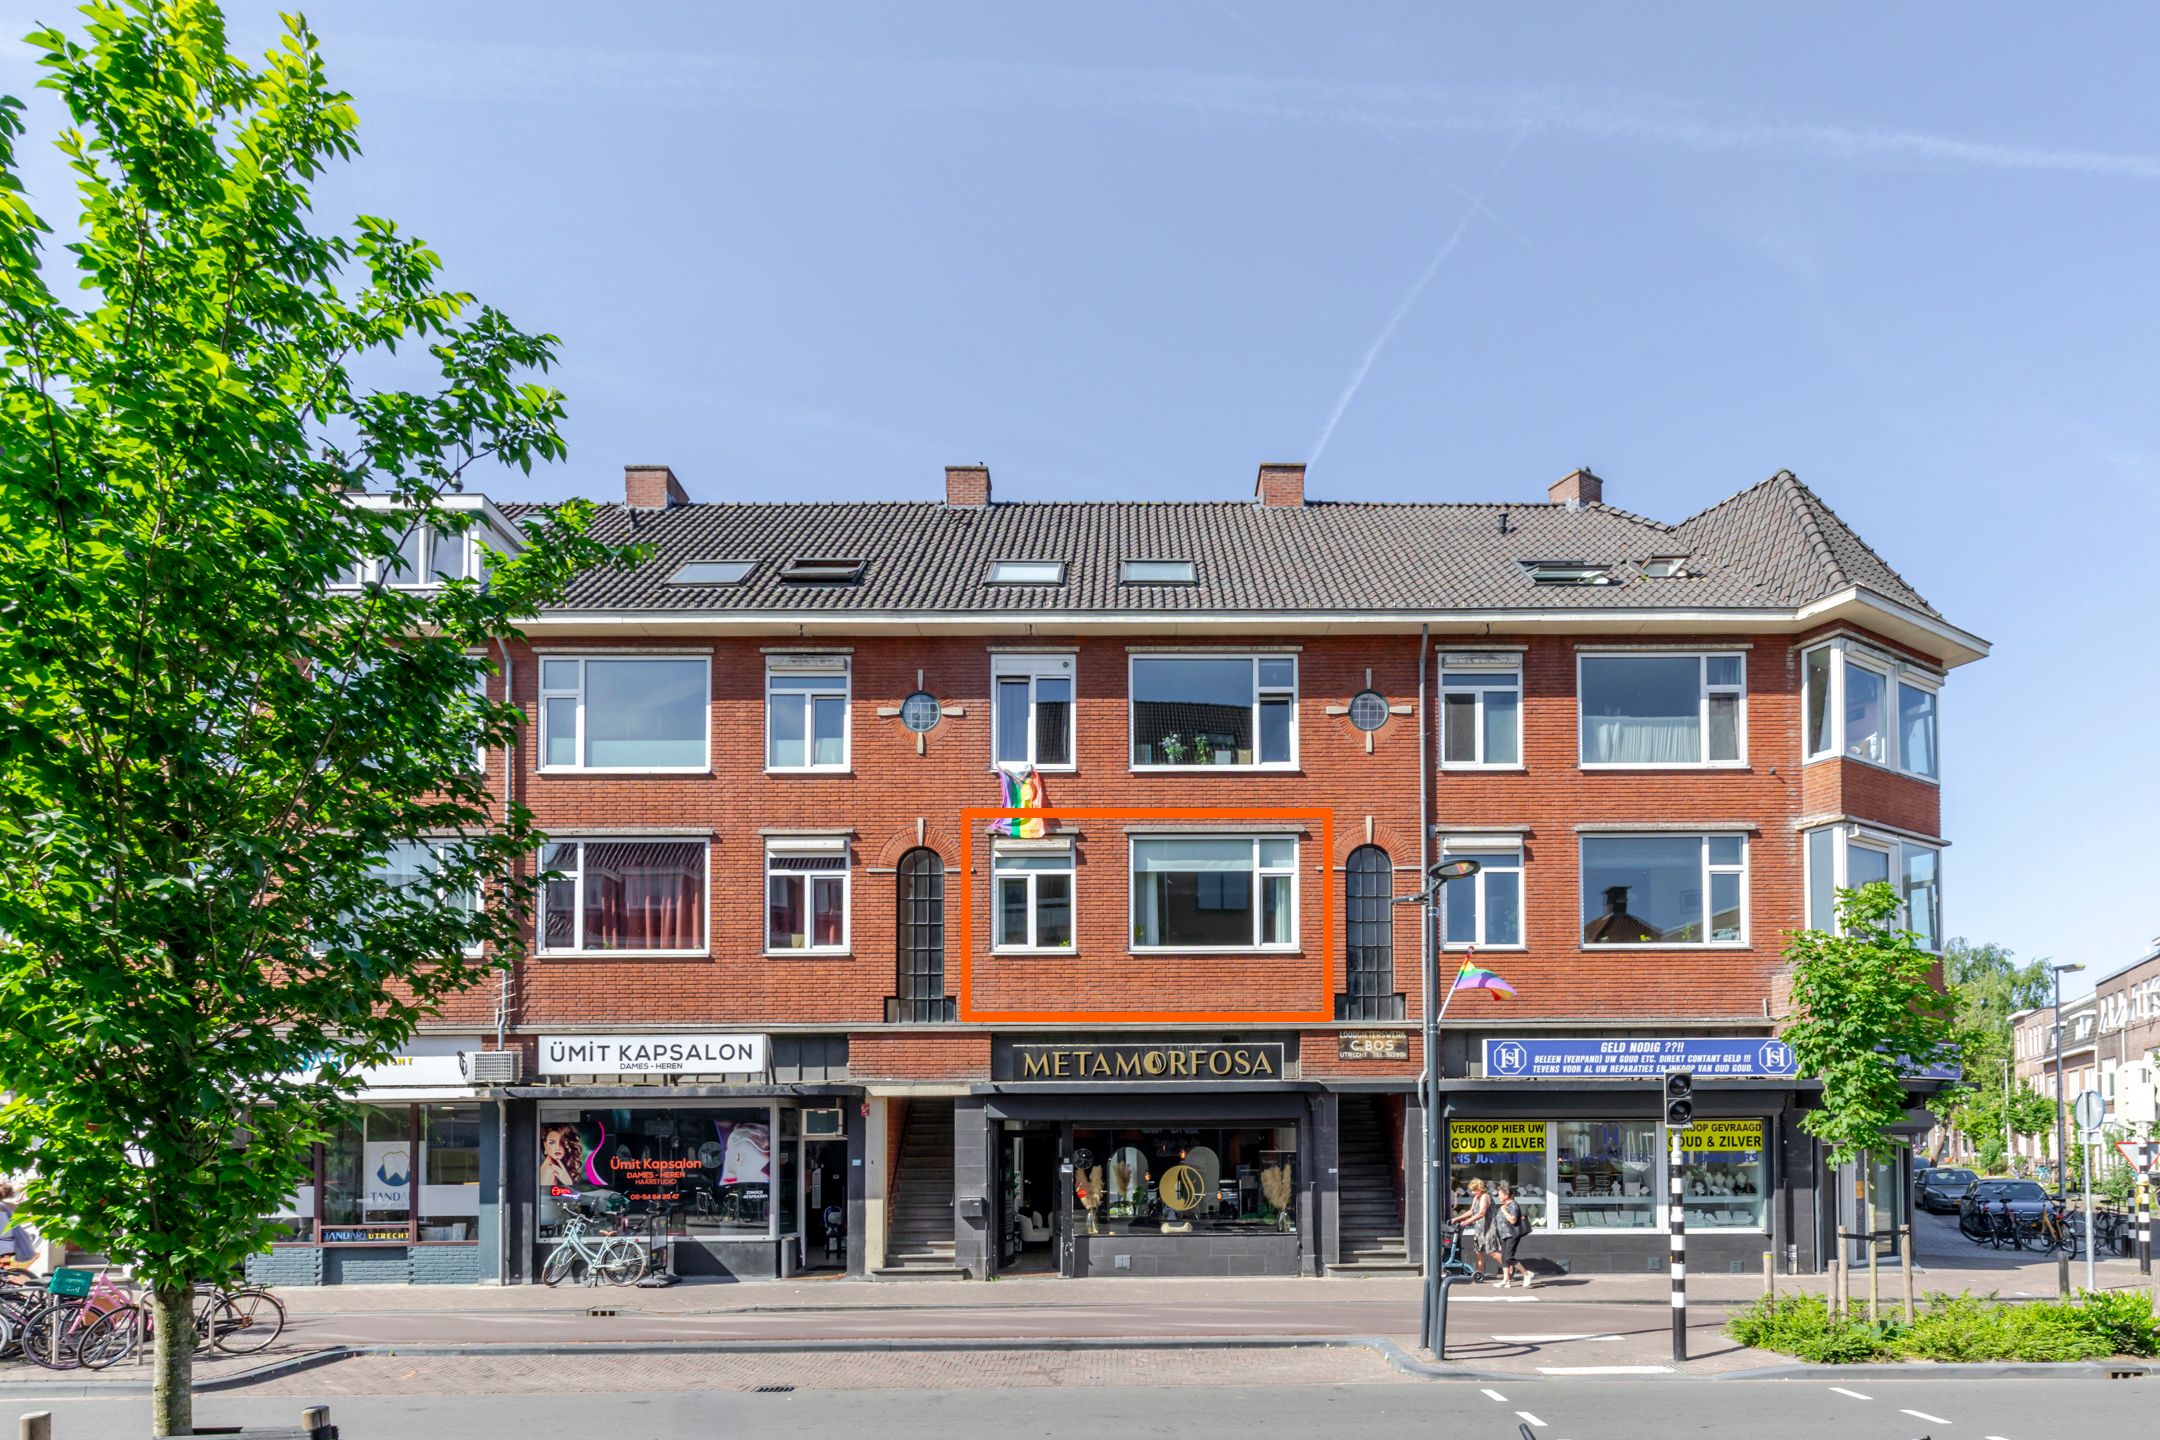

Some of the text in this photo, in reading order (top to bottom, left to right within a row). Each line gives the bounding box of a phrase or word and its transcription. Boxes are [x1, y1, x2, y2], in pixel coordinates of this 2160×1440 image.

[1365, 1040, 1394, 1051] BOS
[1600, 1041, 1685, 1053] GELD NODIG ??!!
[619, 1043, 753, 1061] KAPSALON
[1023, 1050, 1274, 1077] METAMORFOSA
[1534, 1055, 1562, 1064] BELEEN
[1563, 1054, 1603, 1064] (VERPAND)
[1604, 1055, 1618, 1063] UW
[1619, 1055, 1639, 1063] GOUD
[1641, 1054, 1657, 1063] ETC.
[1659, 1054, 1686, 1063] DIREKT
[1687, 1054, 1721, 1063] CONTANT
[1722, 1054, 1741, 1063] GELD
[619, 1062, 649, 1070] DAMES
[655, 1062, 683, 1070] HEREN
[1532, 1065, 1560, 1073] TEVENS
[1562, 1065, 1582, 1073] VOOR
[1583, 1065, 1594, 1073] AL
[1595, 1065, 1607, 1073] UW
[1609, 1064, 1654, 1073] REPARATIES
[1655, 1064, 1667, 1073] EN
[1698, 1064, 1713, 1073] VAN
[1714, 1064, 1730, 1073] OUD
[1731, 1064, 1754, 1073] GOUD.
[1451, 1124, 1545, 1134] VERKOOP HIER UW
[1711, 1123, 1762, 1133] GEVRAAGD
[1451, 1137, 1545, 1149] GOUD & ZILVER
[1707, 1136, 1715, 1148] &
[1719, 1136, 1762, 1148] ZILVER
[610, 1156, 702, 1172] Ümit Kapsalon
[626, 1171, 655, 1179] DAMES
[660, 1171, 686, 1179] HEREN
[367, 1232, 410, 1240] UTRECHT
